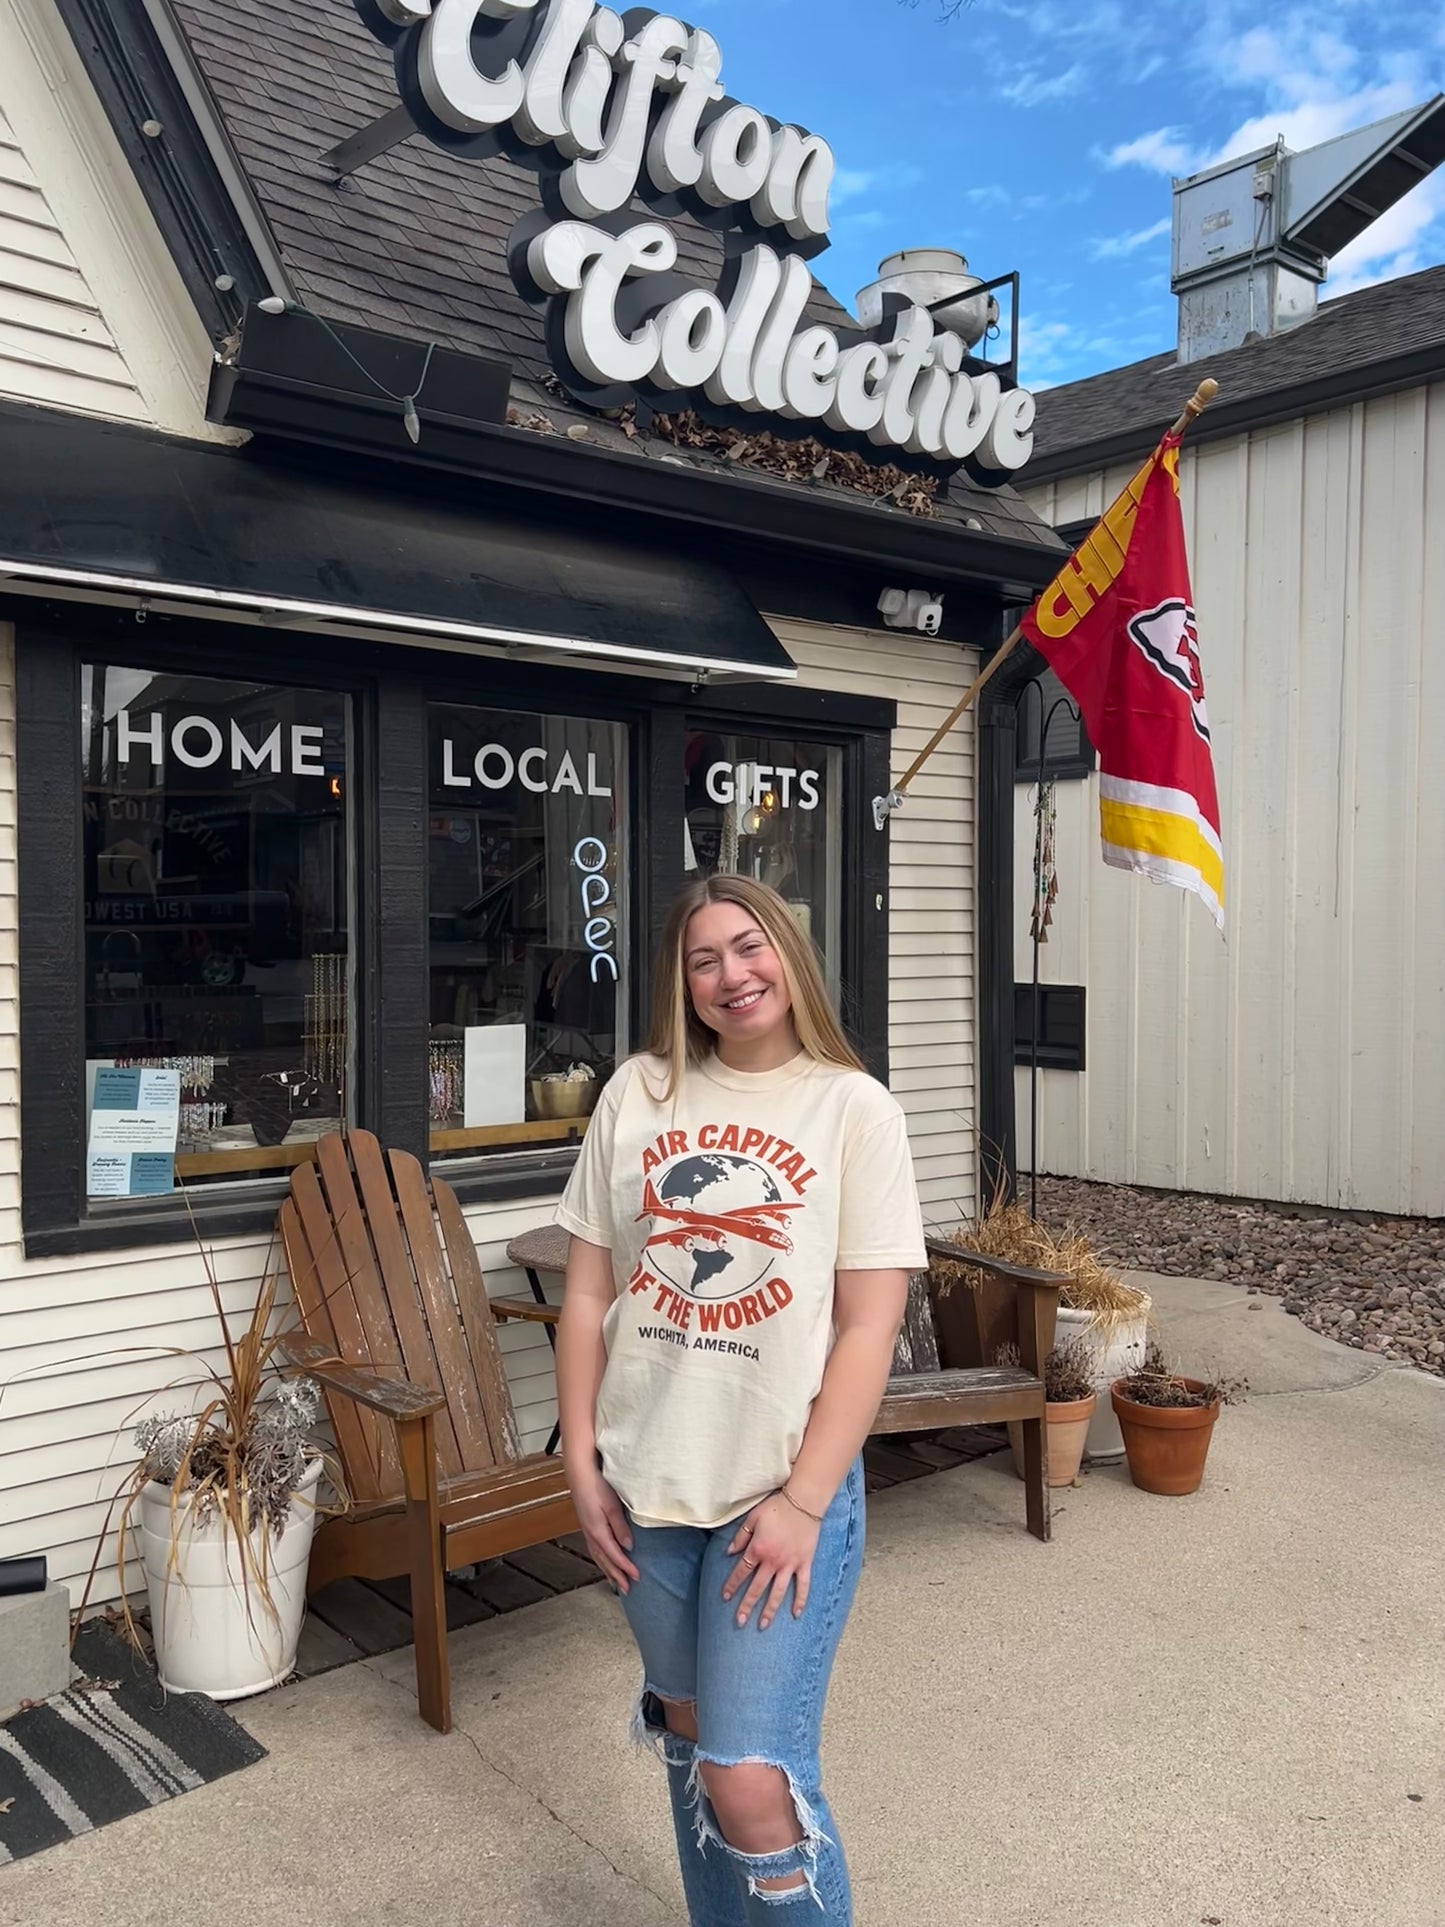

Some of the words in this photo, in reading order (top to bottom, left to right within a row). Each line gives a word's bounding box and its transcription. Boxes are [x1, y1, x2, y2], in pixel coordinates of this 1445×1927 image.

[527, 219, 1036, 471] Collective
[117, 708, 325, 777] HOME
[442, 738, 612, 798] LOCAL
[705, 760, 820, 811] GIFTS
[154, 901, 193, 920] USA
[641, 1129, 690, 1176] AIR
[697, 1123, 819, 1197] CAPITAL
[652, 1281, 695, 1331] THE
[697, 1276, 794, 1333] WORLD
[637, 1325, 690, 1350] WICHITA,
[692, 1336, 760, 1362] AMERICA
